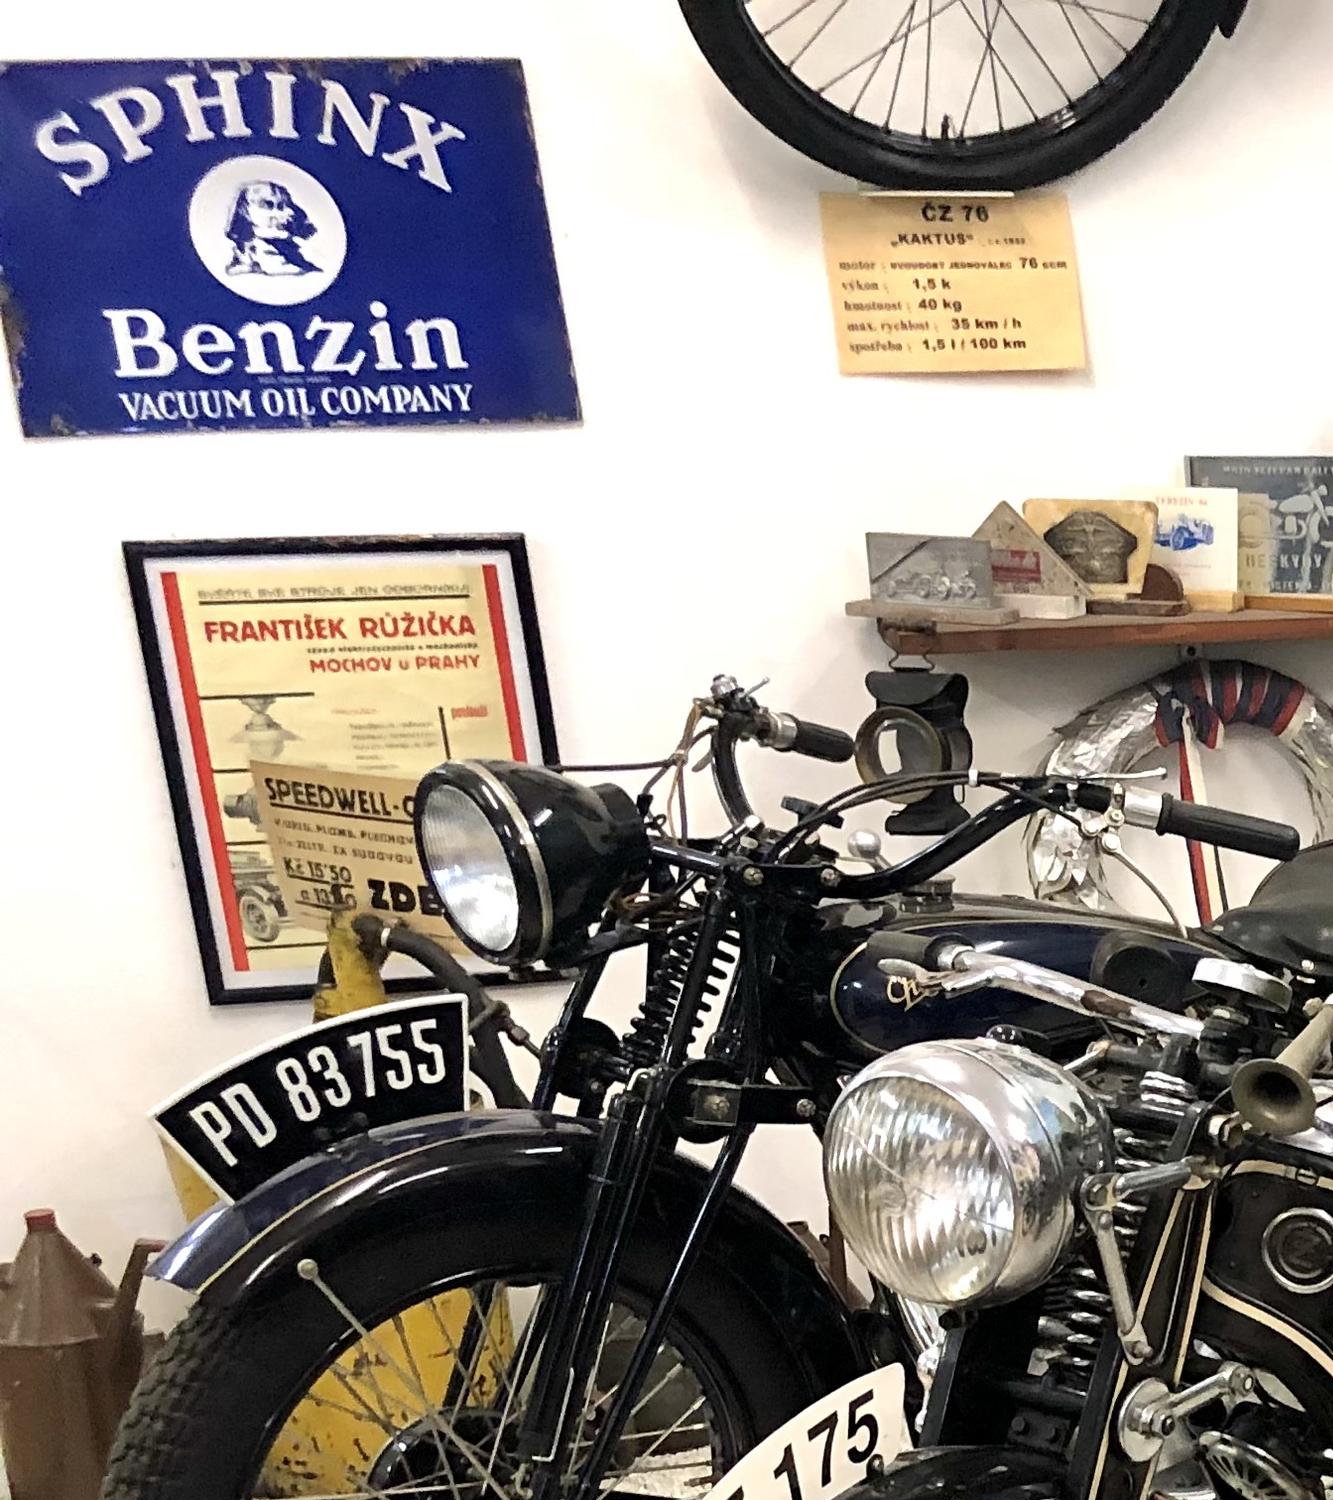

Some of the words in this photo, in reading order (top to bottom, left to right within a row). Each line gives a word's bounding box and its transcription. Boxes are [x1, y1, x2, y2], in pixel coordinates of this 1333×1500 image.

[35, 69, 465, 196] SPHINX
[921, 202, 953, 223] ČZ
[964, 205, 989, 222] 76
[1019, 257, 1038, 269] 76
[912, 278, 936, 292] 1,5
[941, 278, 952, 289] k
[918, 299, 937, 310] 40
[942, 299, 962, 312] kg
[951, 318, 970, 330] 35
[975, 318, 998, 329] km
[103, 302, 469, 377] Benzin
[922, 339, 946, 352] 1,5
[970, 339, 998, 349] 100
[1003, 338, 1026, 349] km
[119, 387, 253, 422] VACUUM
[262, 386, 316, 419] OIL
[322, 383, 473, 416] COMPANY
[204, 614, 348, 643] FRANTIŠEK
[359, 611, 476, 639] RŮŽIČKA
[310, 657, 392, 673] MOCHOV
[415, 654, 480, 670] PRAHY
[188, 1082, 277, 1167] PD
[276, 1018, 446, 1123] 83755
